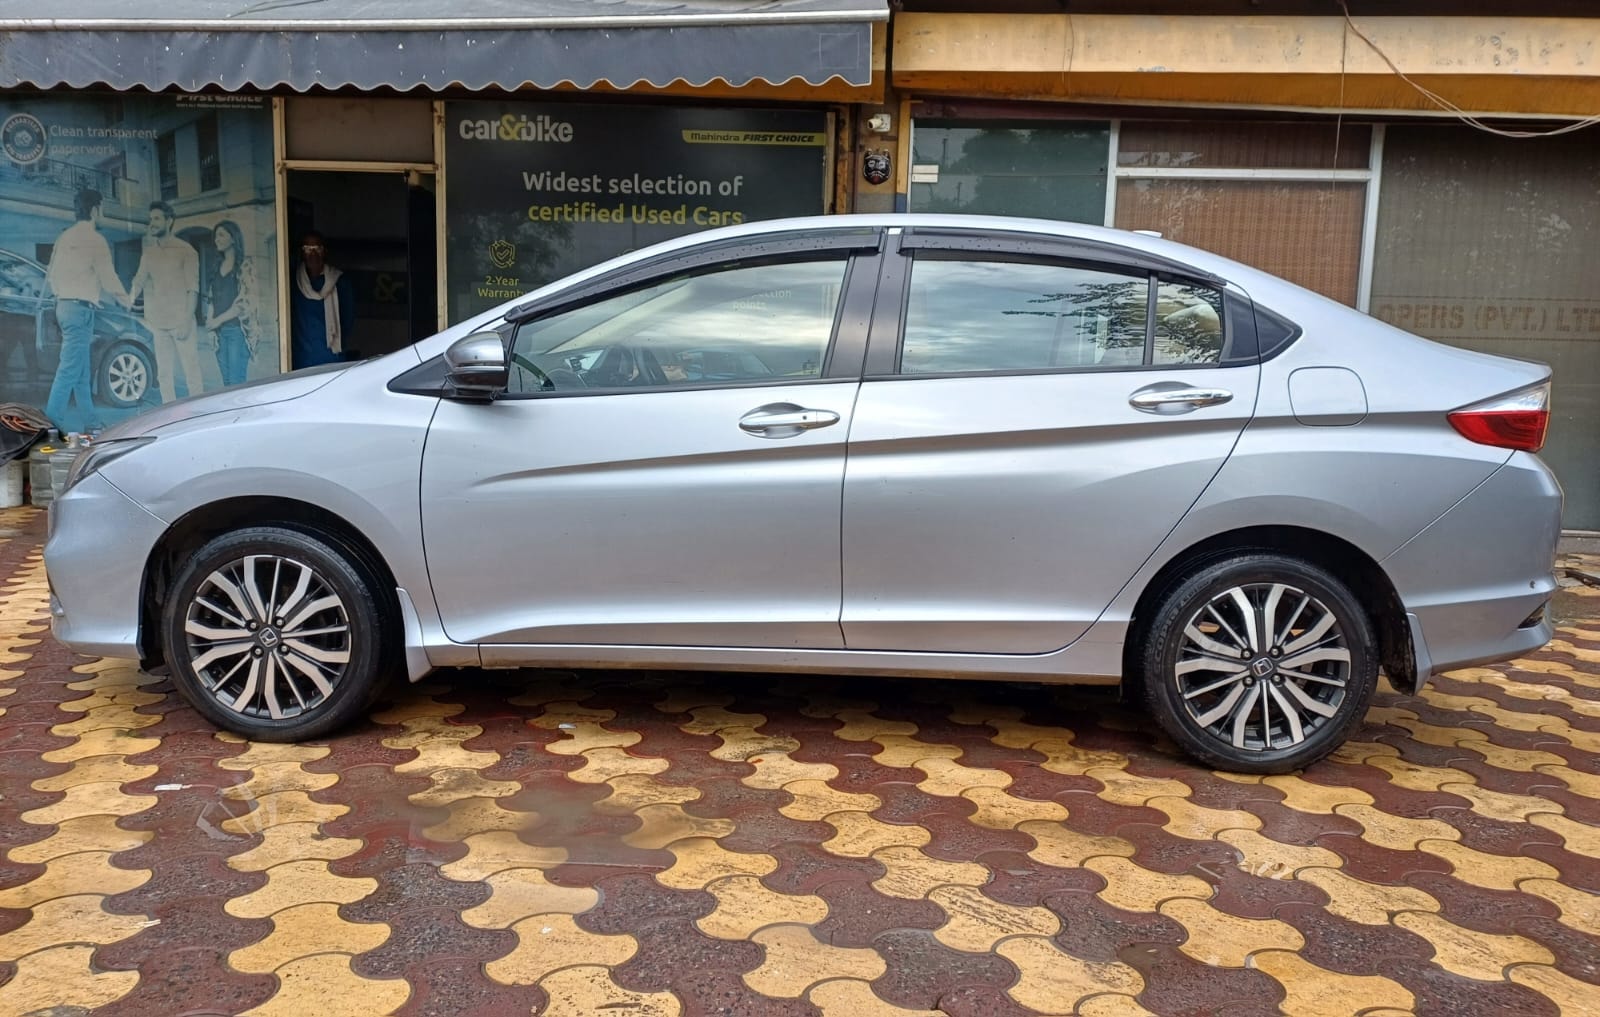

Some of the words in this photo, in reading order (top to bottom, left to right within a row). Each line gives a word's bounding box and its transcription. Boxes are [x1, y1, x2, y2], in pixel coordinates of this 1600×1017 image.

[50, 125, 84, 137] Clean
[87, 127, 158, 141] transparent
[459, 113, 574, 143] car&bike
[691, 132, 740, 142] Mahindra
[743, 134, 775, 143] FIRST
[775, 134, 815, 143] CHOICE
[522, 171, 602, 194] Widest
[608, 174, 712, 195] selection
[718, 176, 744, 196] of
[528, 202, 625, 224] certified
[631, 204, 687, 225] Used
[693, 206, 744, 226] Cars
[485, 275, 520, 287] 2-Year
